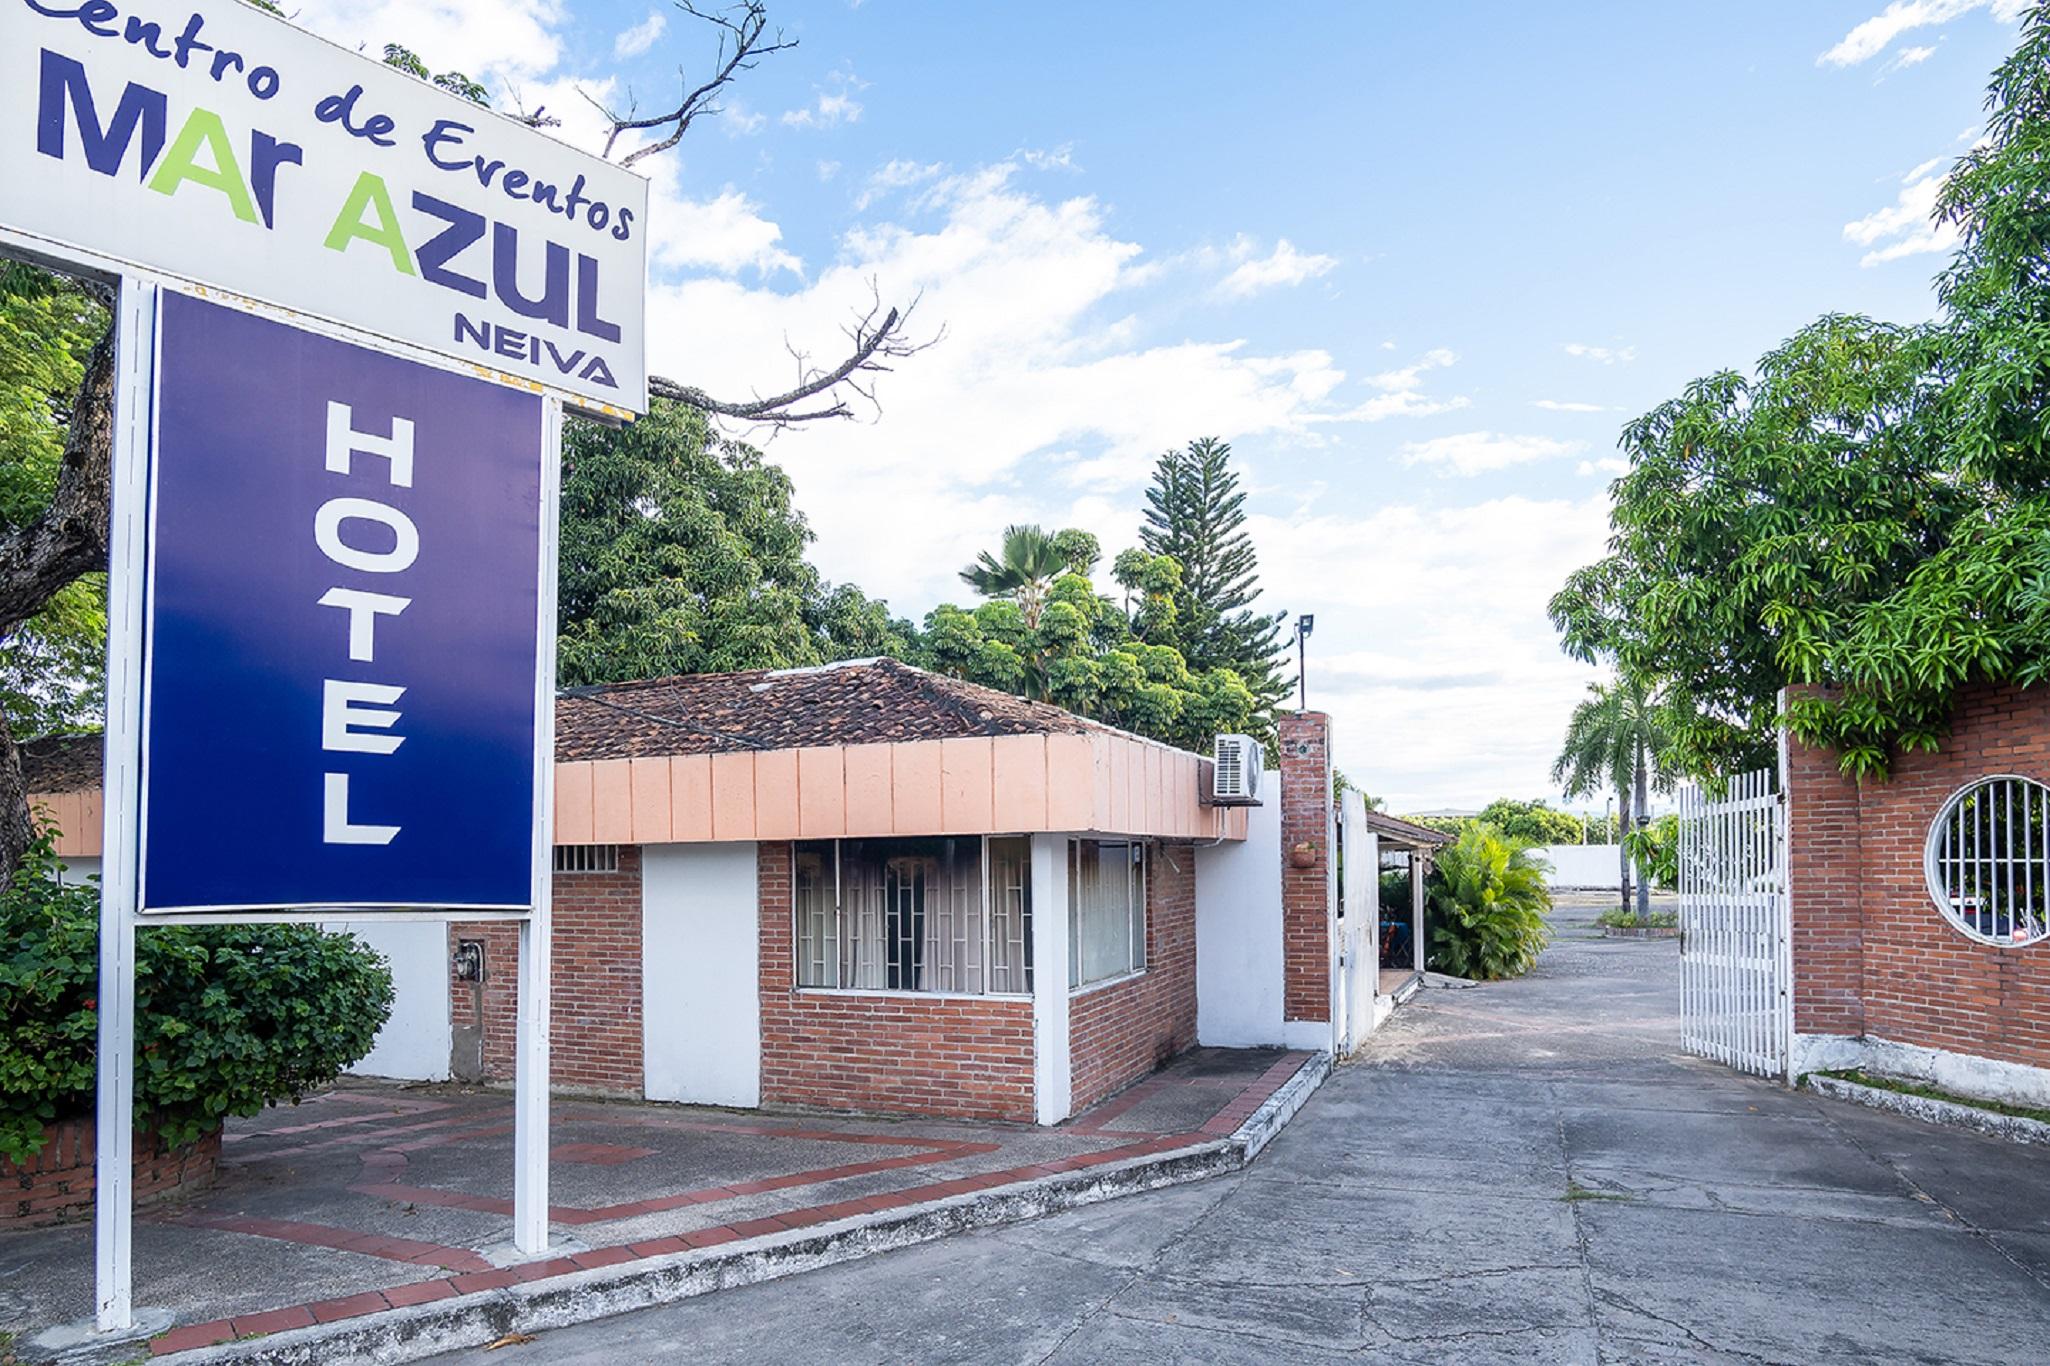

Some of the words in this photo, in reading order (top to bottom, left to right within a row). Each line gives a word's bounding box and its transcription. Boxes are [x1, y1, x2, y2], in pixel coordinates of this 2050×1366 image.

[24, 0, 281, 101] entro
[314, 84, 396, 147] de
[421, 119, 635, 241] Eventos
[323, 170, 622, 344] AZUL
[454, 312, 620, 389] NEIVA
[313, 399, 421, 846] HOTEL
